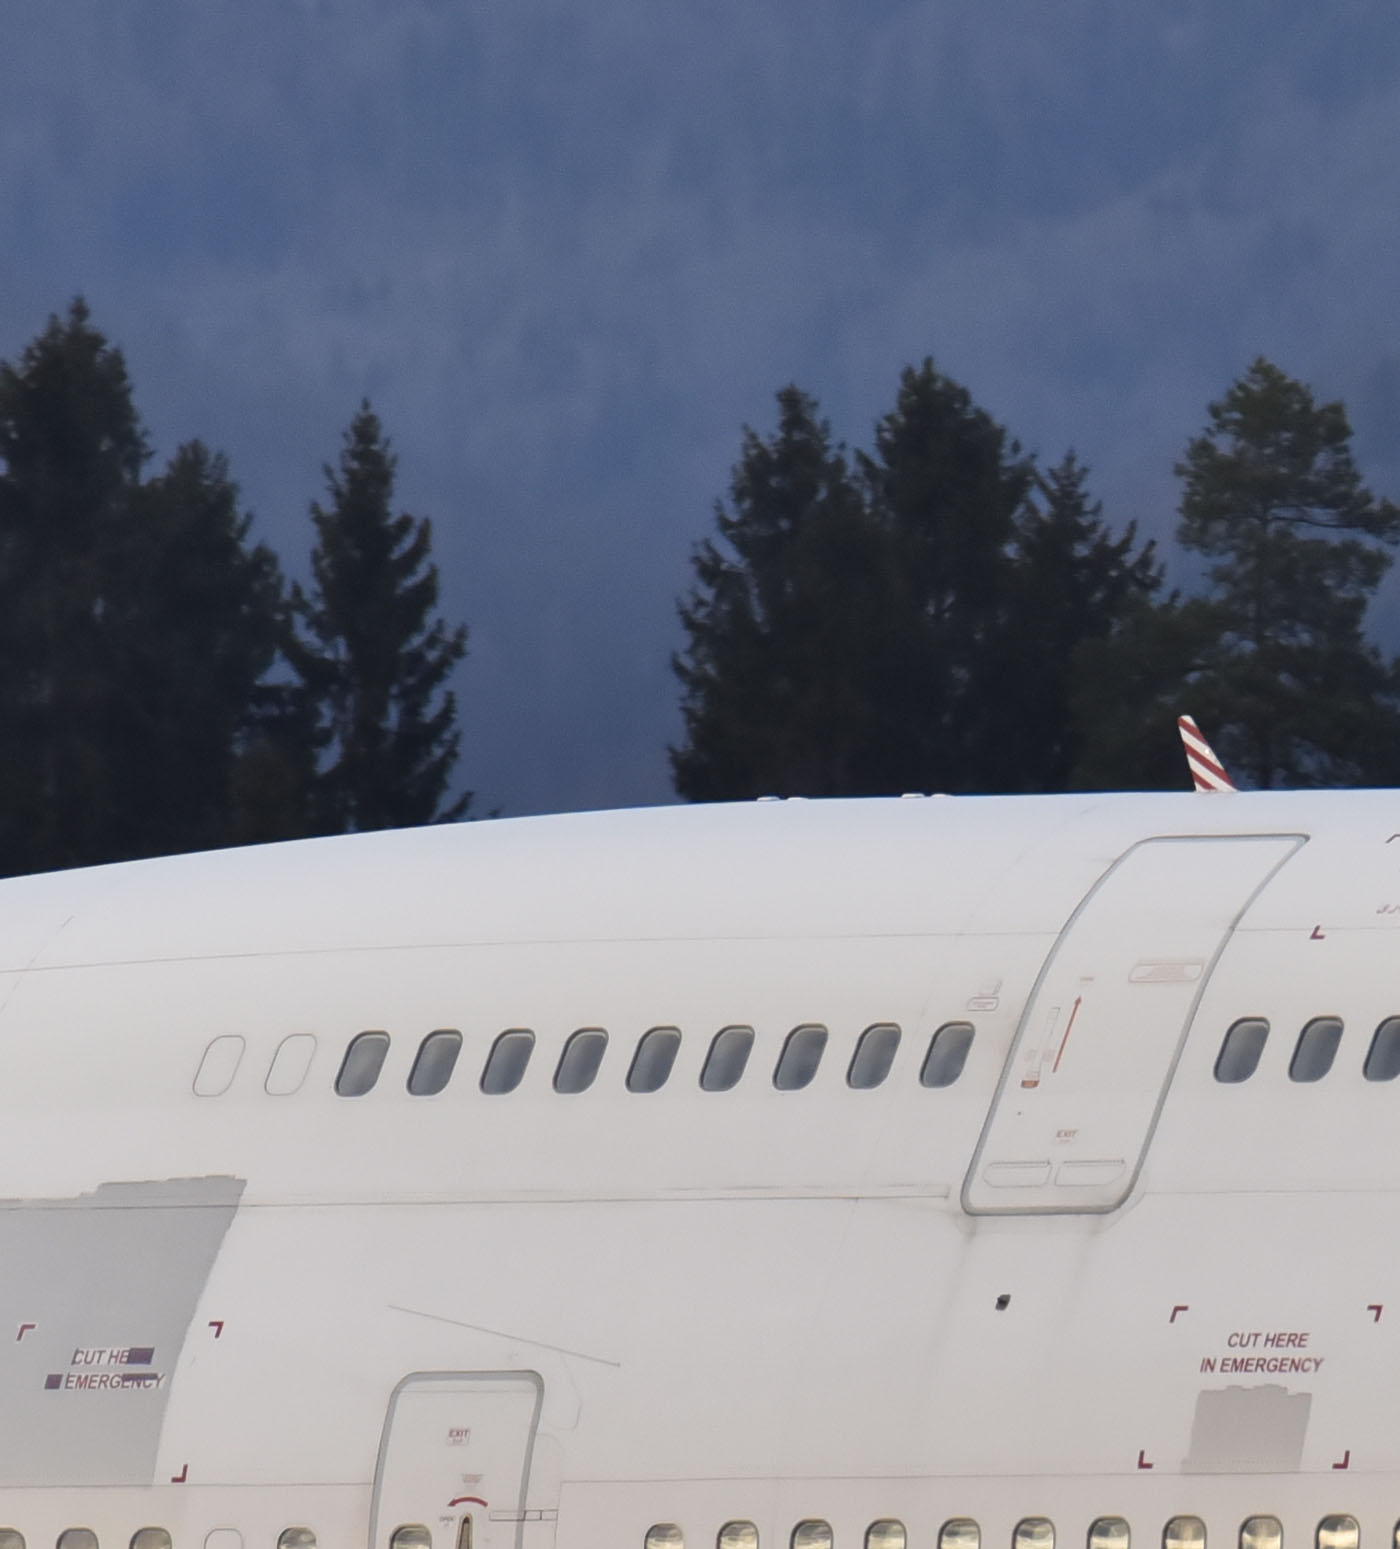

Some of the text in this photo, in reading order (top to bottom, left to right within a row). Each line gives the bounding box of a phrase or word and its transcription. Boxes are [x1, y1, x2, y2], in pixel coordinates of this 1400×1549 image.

[1227, 1333, 1309, 1348] CUT HERE
[74, 1349, 107, 1365] CUT
[1200, 1358, 1324, 1373] IN EMERGENCY
[448, 1429, 471, 1438] EXIT
